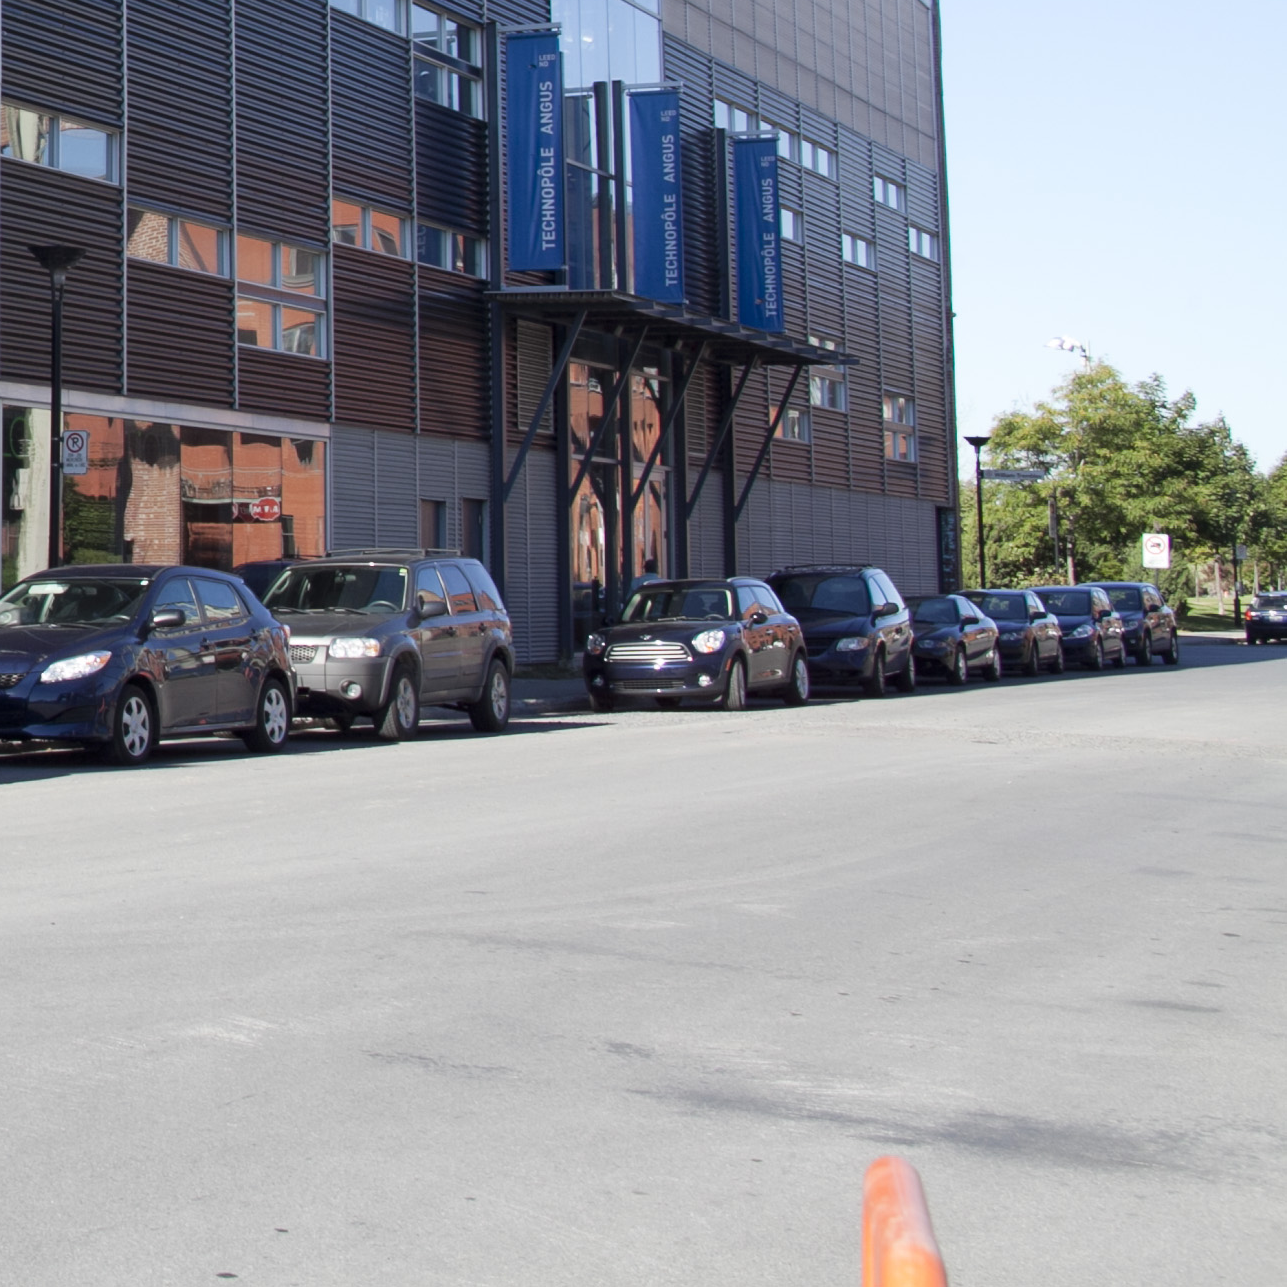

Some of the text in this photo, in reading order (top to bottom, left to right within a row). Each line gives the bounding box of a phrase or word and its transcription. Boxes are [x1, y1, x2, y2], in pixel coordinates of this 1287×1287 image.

[537, 81, 556, 251] TECHNOPÔLE ANGUS
[660, 134, 678, 287] TECHNOPÔLE ANGUS
[760, 178, 778, 318] TECHNOPÔLE ANGUS
